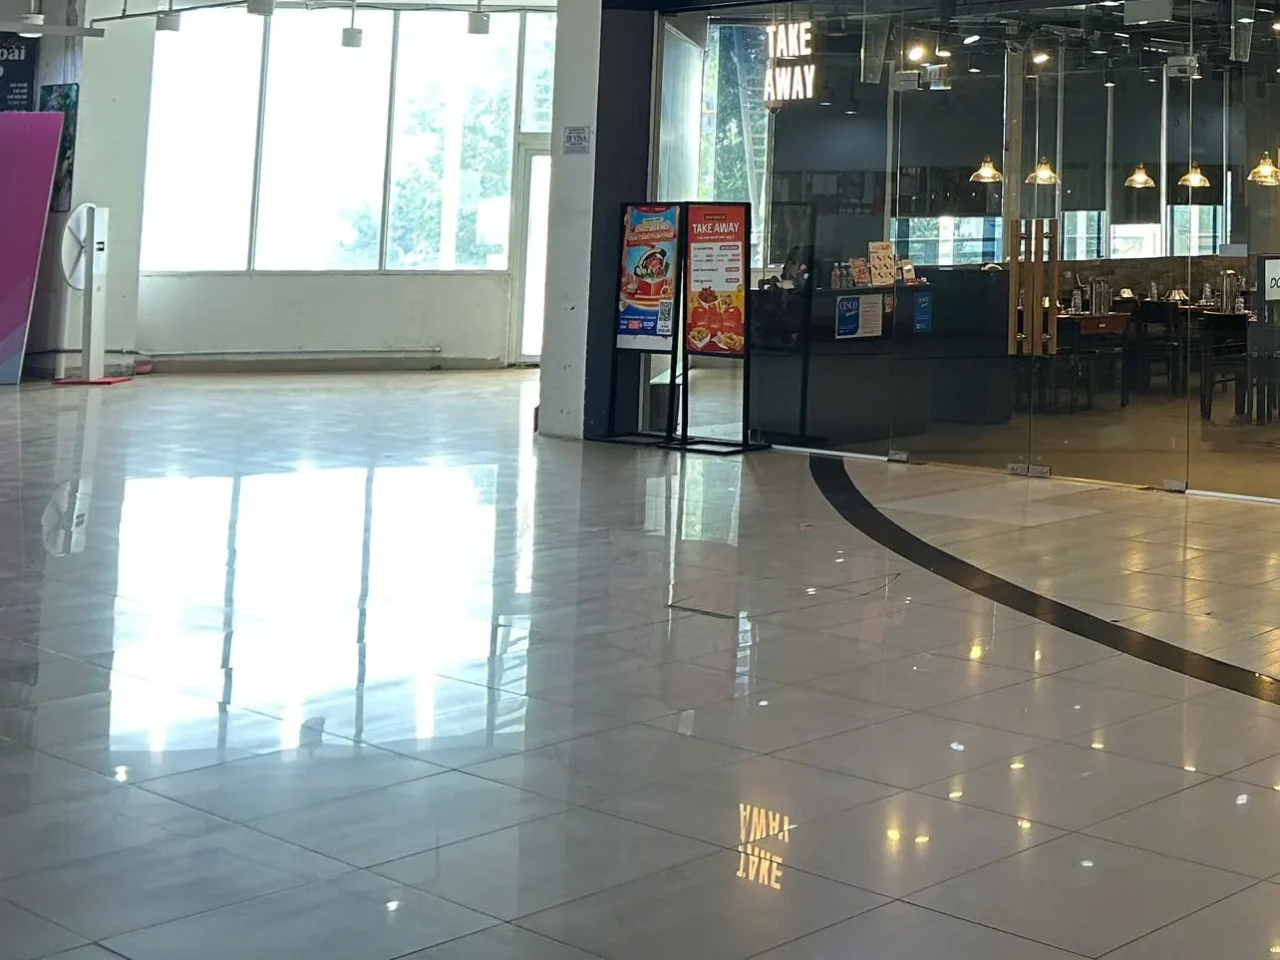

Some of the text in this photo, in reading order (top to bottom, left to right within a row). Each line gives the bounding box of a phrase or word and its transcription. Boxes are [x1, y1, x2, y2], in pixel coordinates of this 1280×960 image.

[766, 21, 812, 58] TAKE
[763, 64, 815, 101] AWAY
[692, 222, 740, 233] TAKE AWAY
